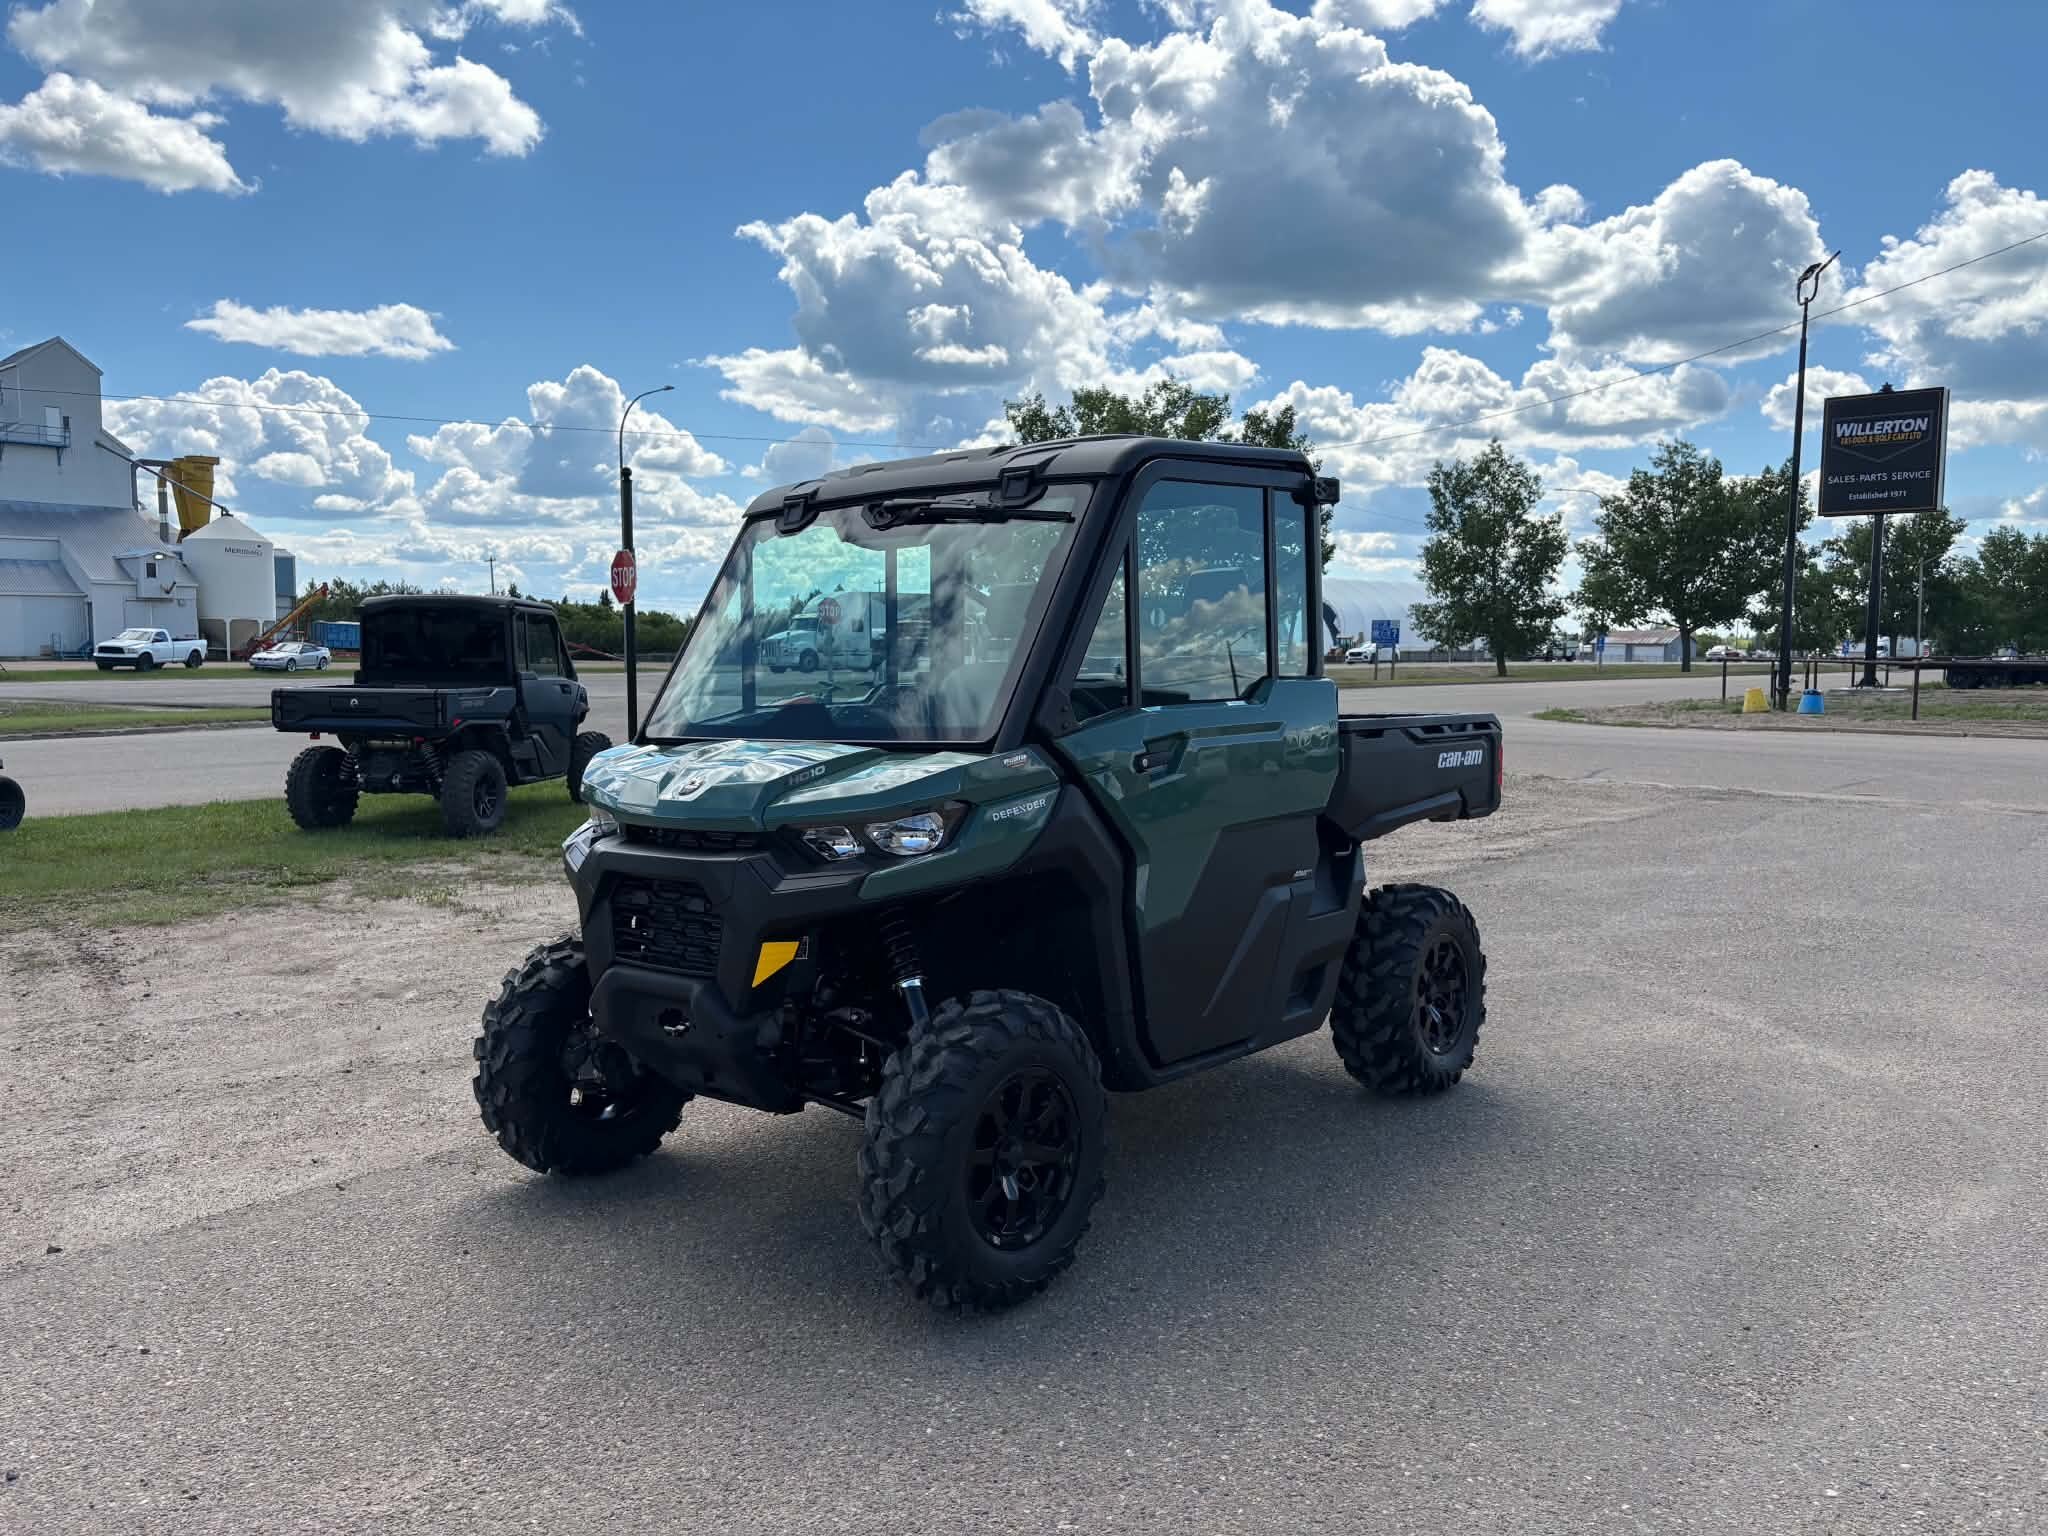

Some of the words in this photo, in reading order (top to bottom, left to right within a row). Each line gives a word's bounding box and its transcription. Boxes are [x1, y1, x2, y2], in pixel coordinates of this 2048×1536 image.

[1836, 417, 1928, 438] WILLERTON
[1828, 474, 1855, 485] SALES
[1860, 472, 1888, 482] PARTS
[1891, 470, 1931, 480] SERVICE
[1848, 489, 1888, 500] Established
[1890, 489, 1907, 498] 1971
[612, 567, 635, 587] STOP
[992, 798, 1047, 821] DEFENDER
